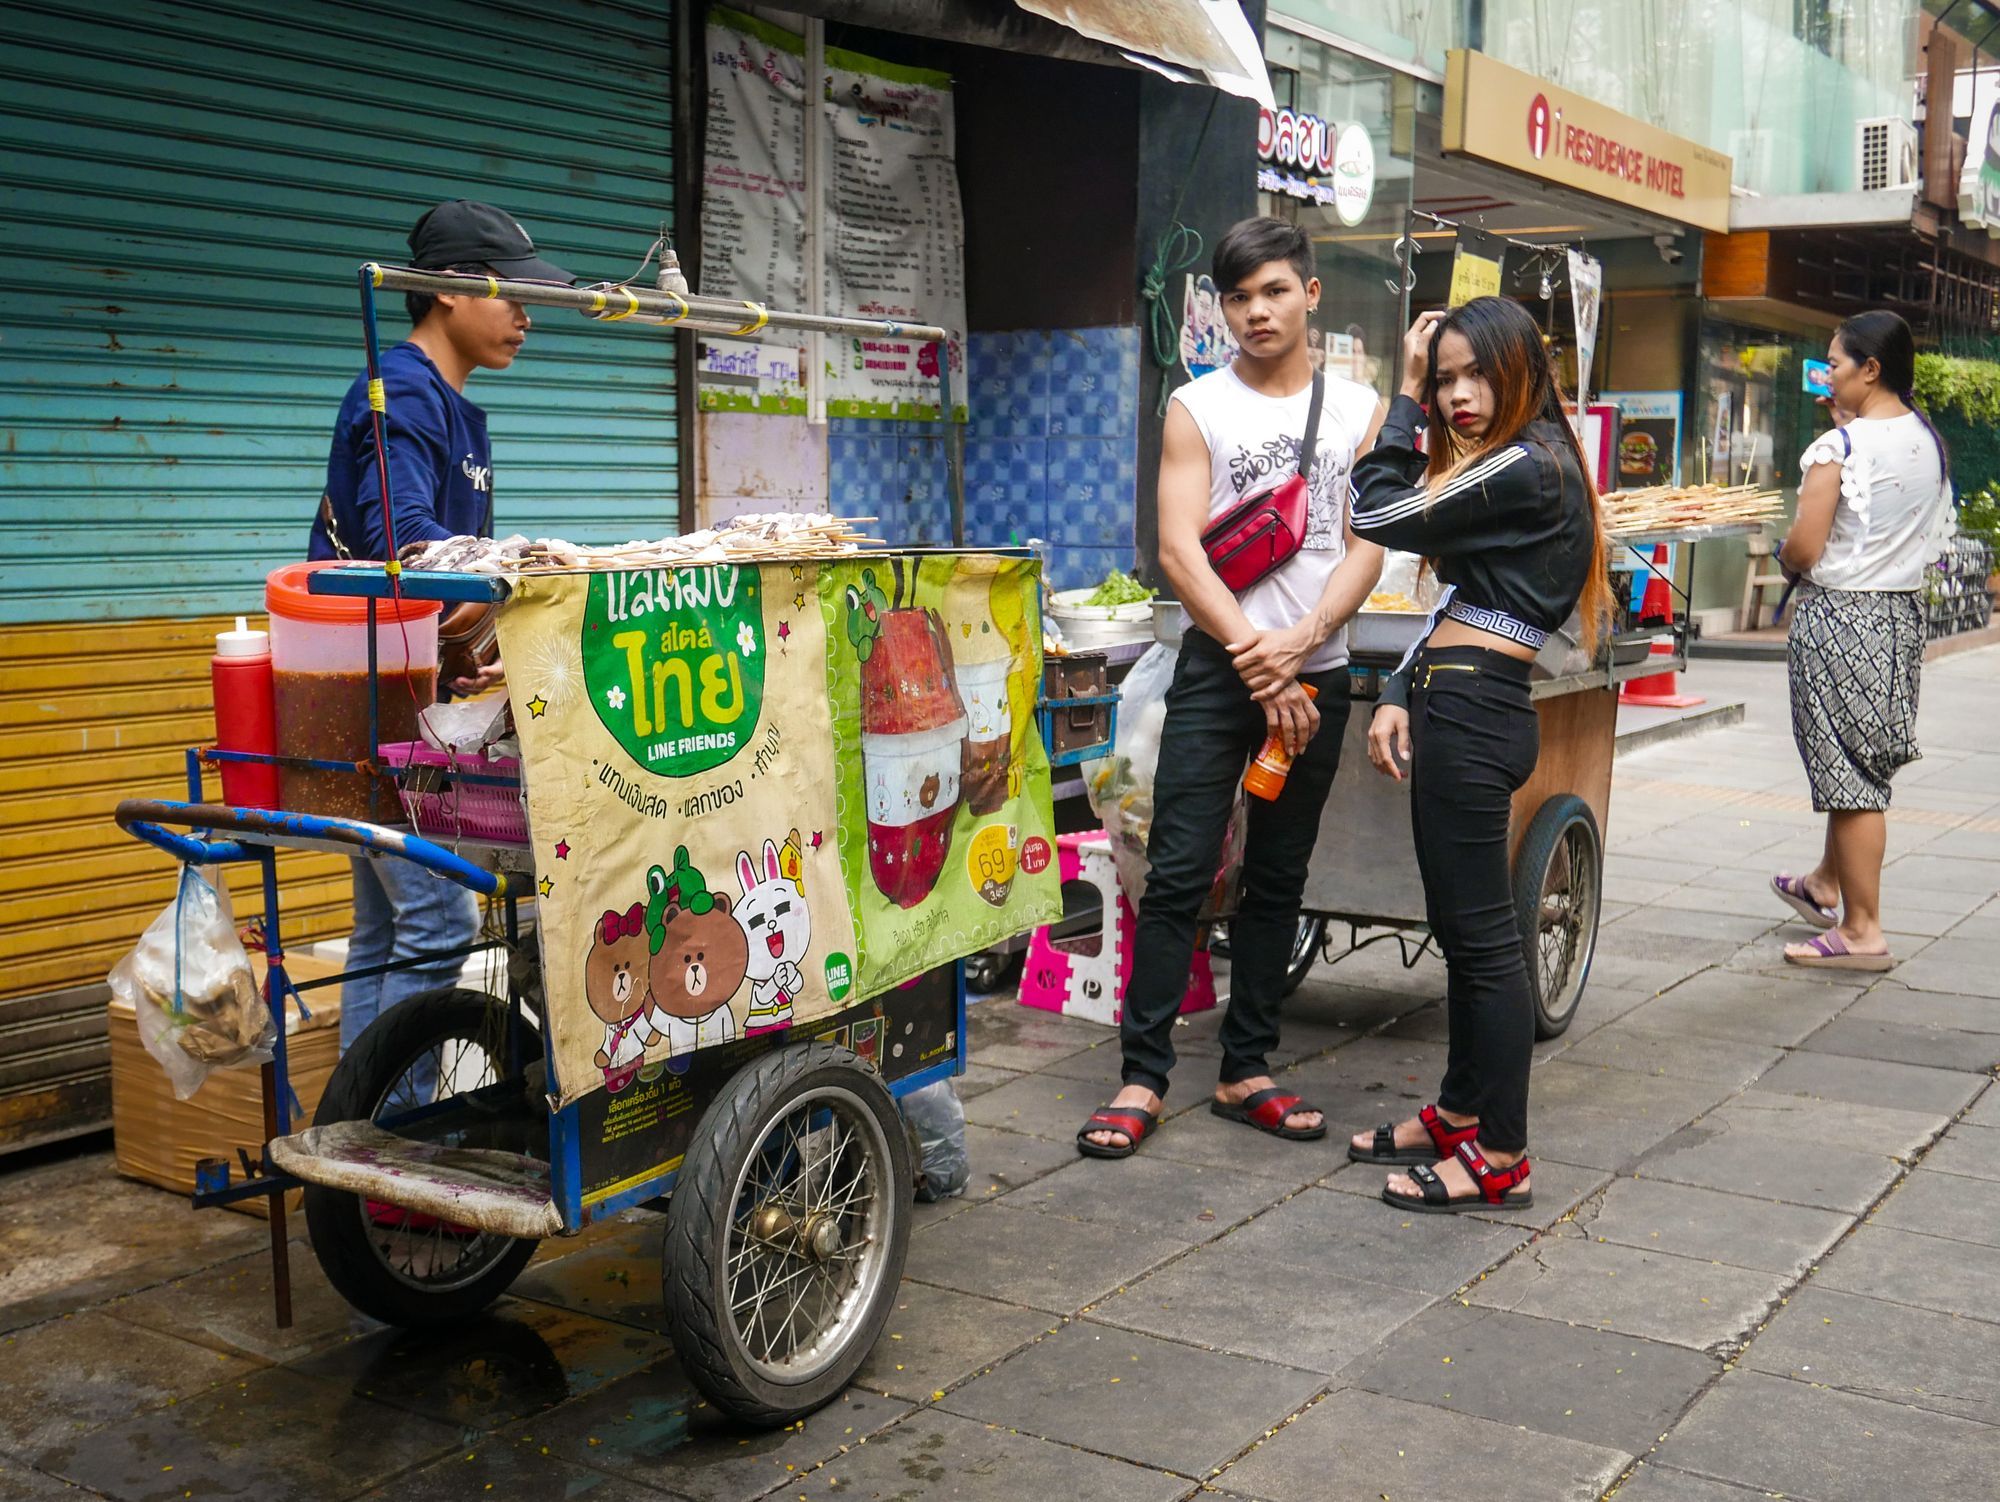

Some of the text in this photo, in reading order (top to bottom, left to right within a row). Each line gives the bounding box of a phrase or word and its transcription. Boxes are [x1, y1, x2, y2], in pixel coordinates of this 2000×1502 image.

[1565, 124, 1643, 184] RESIDENCE
[1646, 155, 1684, 199] HOTEL
[612, 630, 744, 737] ไทย
[648, 731, 736, 761] LINE FRIENDS
[754, 722, 782, 776] ทำบุญ
[598, 762, 667, 819] แทนเงินสด
[684, 779, 744, 818] แลกของ
[978, 848, 1005, 878] 69
[826, 964, 847, 982] LINE
